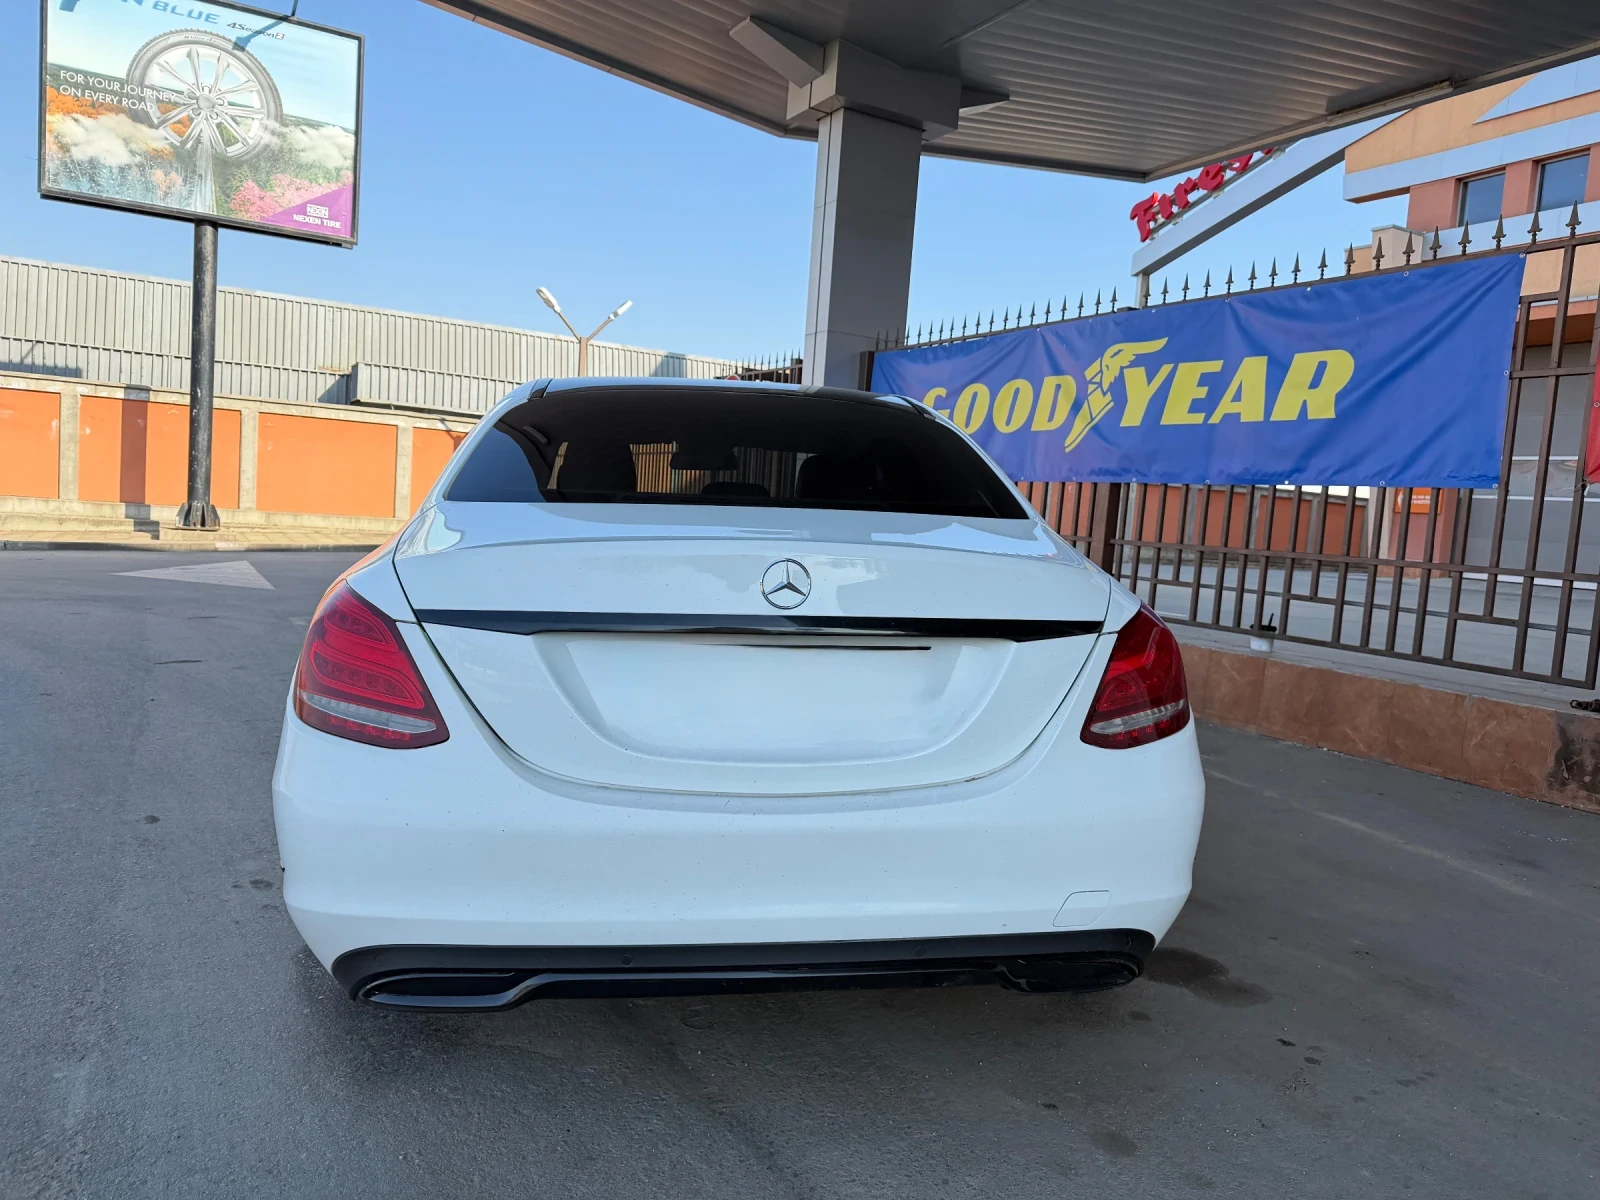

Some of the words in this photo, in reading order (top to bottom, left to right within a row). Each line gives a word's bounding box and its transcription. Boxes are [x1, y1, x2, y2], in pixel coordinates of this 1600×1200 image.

[152, 1, 220, 24] BLUE
[59, 85, 81, 97] ON
[85, 90, 119, 104] EVERY
[122, 98, 155, 112] ROAD
[60, 70, 85, 84] FOR
[87, 76, 120, 91] YOUR
[122, 84, 176, 102] JOURNEY
[1130, 147, 1275, 243] Fires
[293, 214, 321, 225] NEXEN
[322, 219, 341, 229] TIRE
